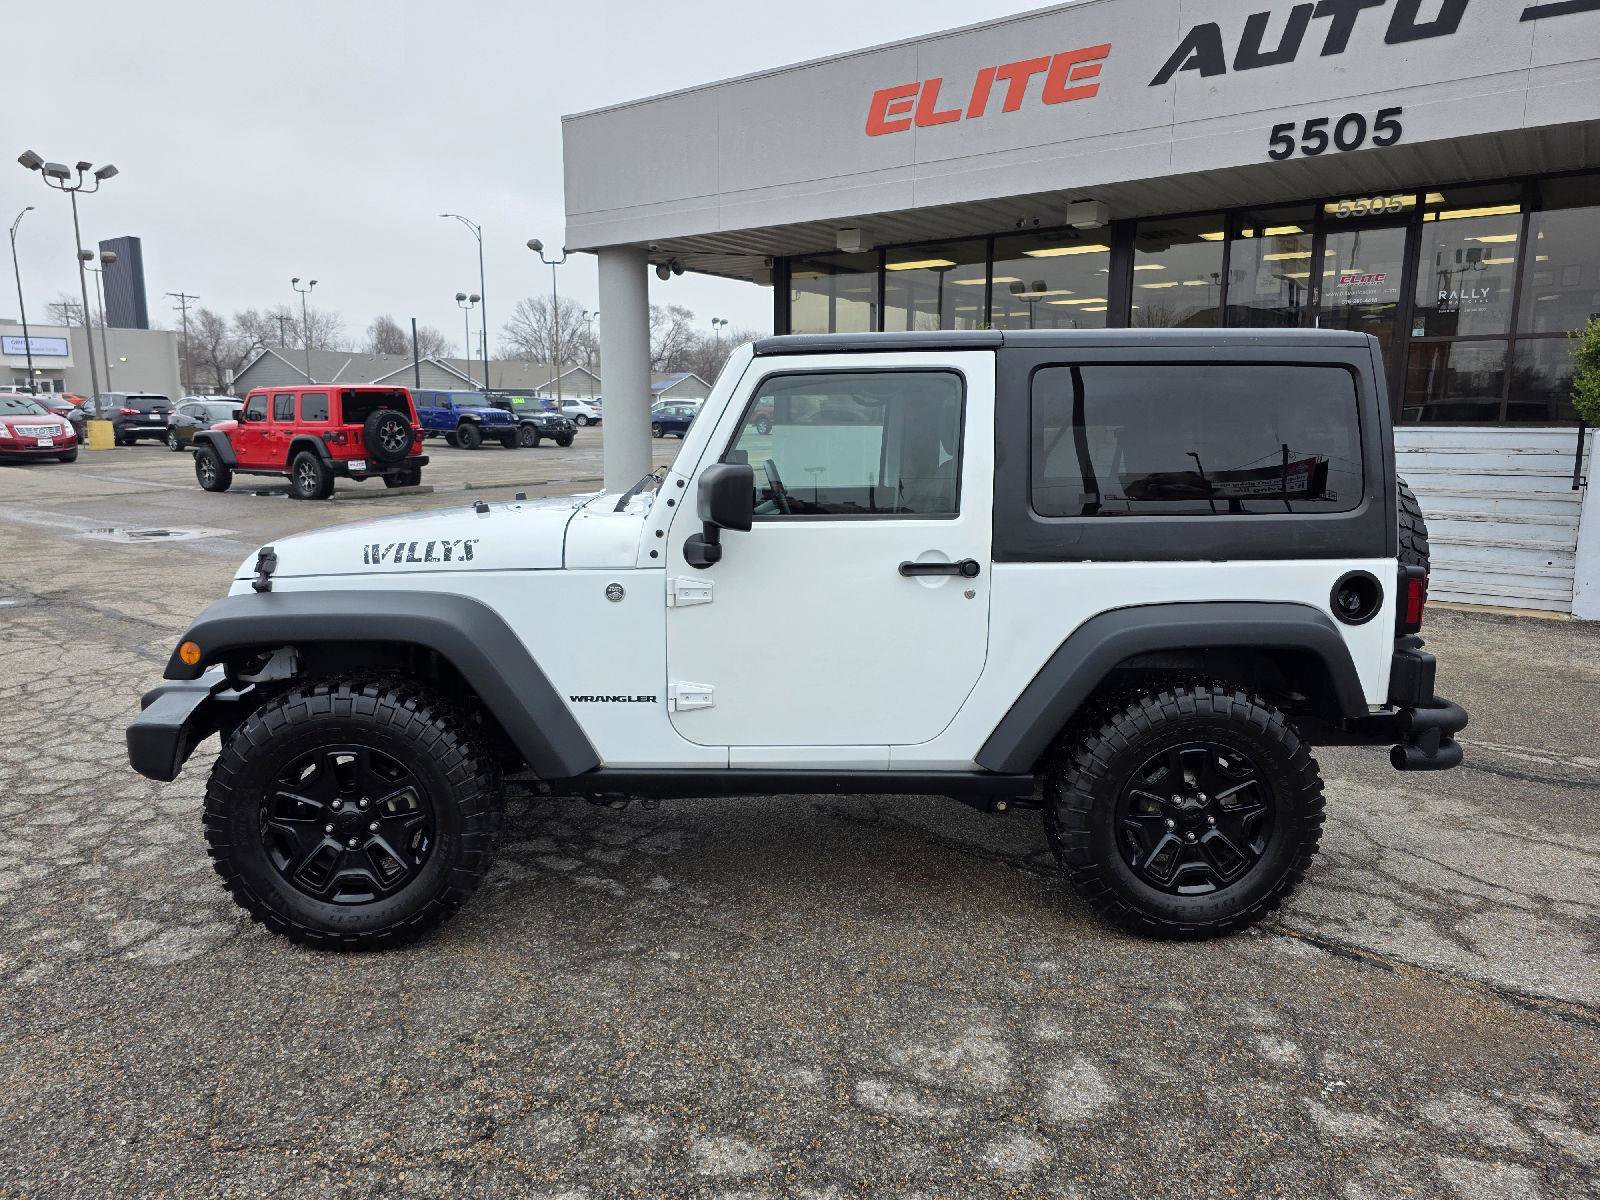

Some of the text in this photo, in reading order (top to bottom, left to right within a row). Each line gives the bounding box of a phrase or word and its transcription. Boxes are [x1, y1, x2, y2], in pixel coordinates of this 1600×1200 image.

[865, 0, 1469, 137] ELITE AUTO
[1268, 107, 1403, 160] 5505
[1336, 194, 1403, 218] 5505
[1339, 273, 1387, 285] ELITE
[1438, 288, 1490, 300] RALLY
[363, 538, 480, 564] WILLYS
[569, 695, 658, 704] WRANGLER
